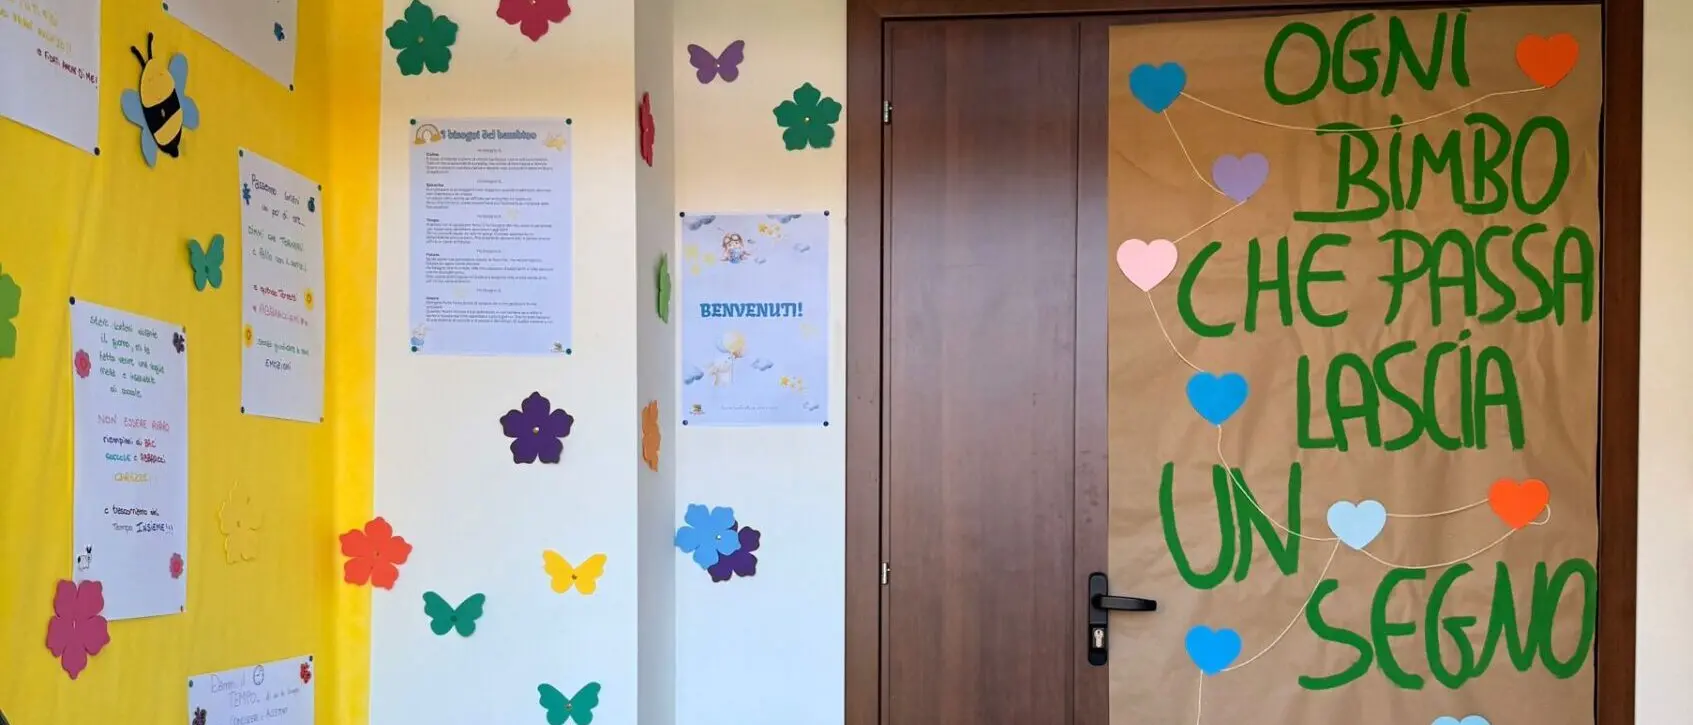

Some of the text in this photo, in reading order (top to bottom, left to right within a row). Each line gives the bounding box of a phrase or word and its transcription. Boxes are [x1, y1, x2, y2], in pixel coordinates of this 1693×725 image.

[1264, 9, 1471, 105] OGNI
[497, 129, 537, 140] bambino
[1293, 112, 1570, 222] BIMBO
[700, 302, 803, 318] BENVENUTI!
[1177, 222, 1594, 337] CHE PASSA
[1297, 330, 1525, 451] LASCIA
[1159, 461, 1301, 590] UN
[1298, 557, 1597, 690] SEGNO
